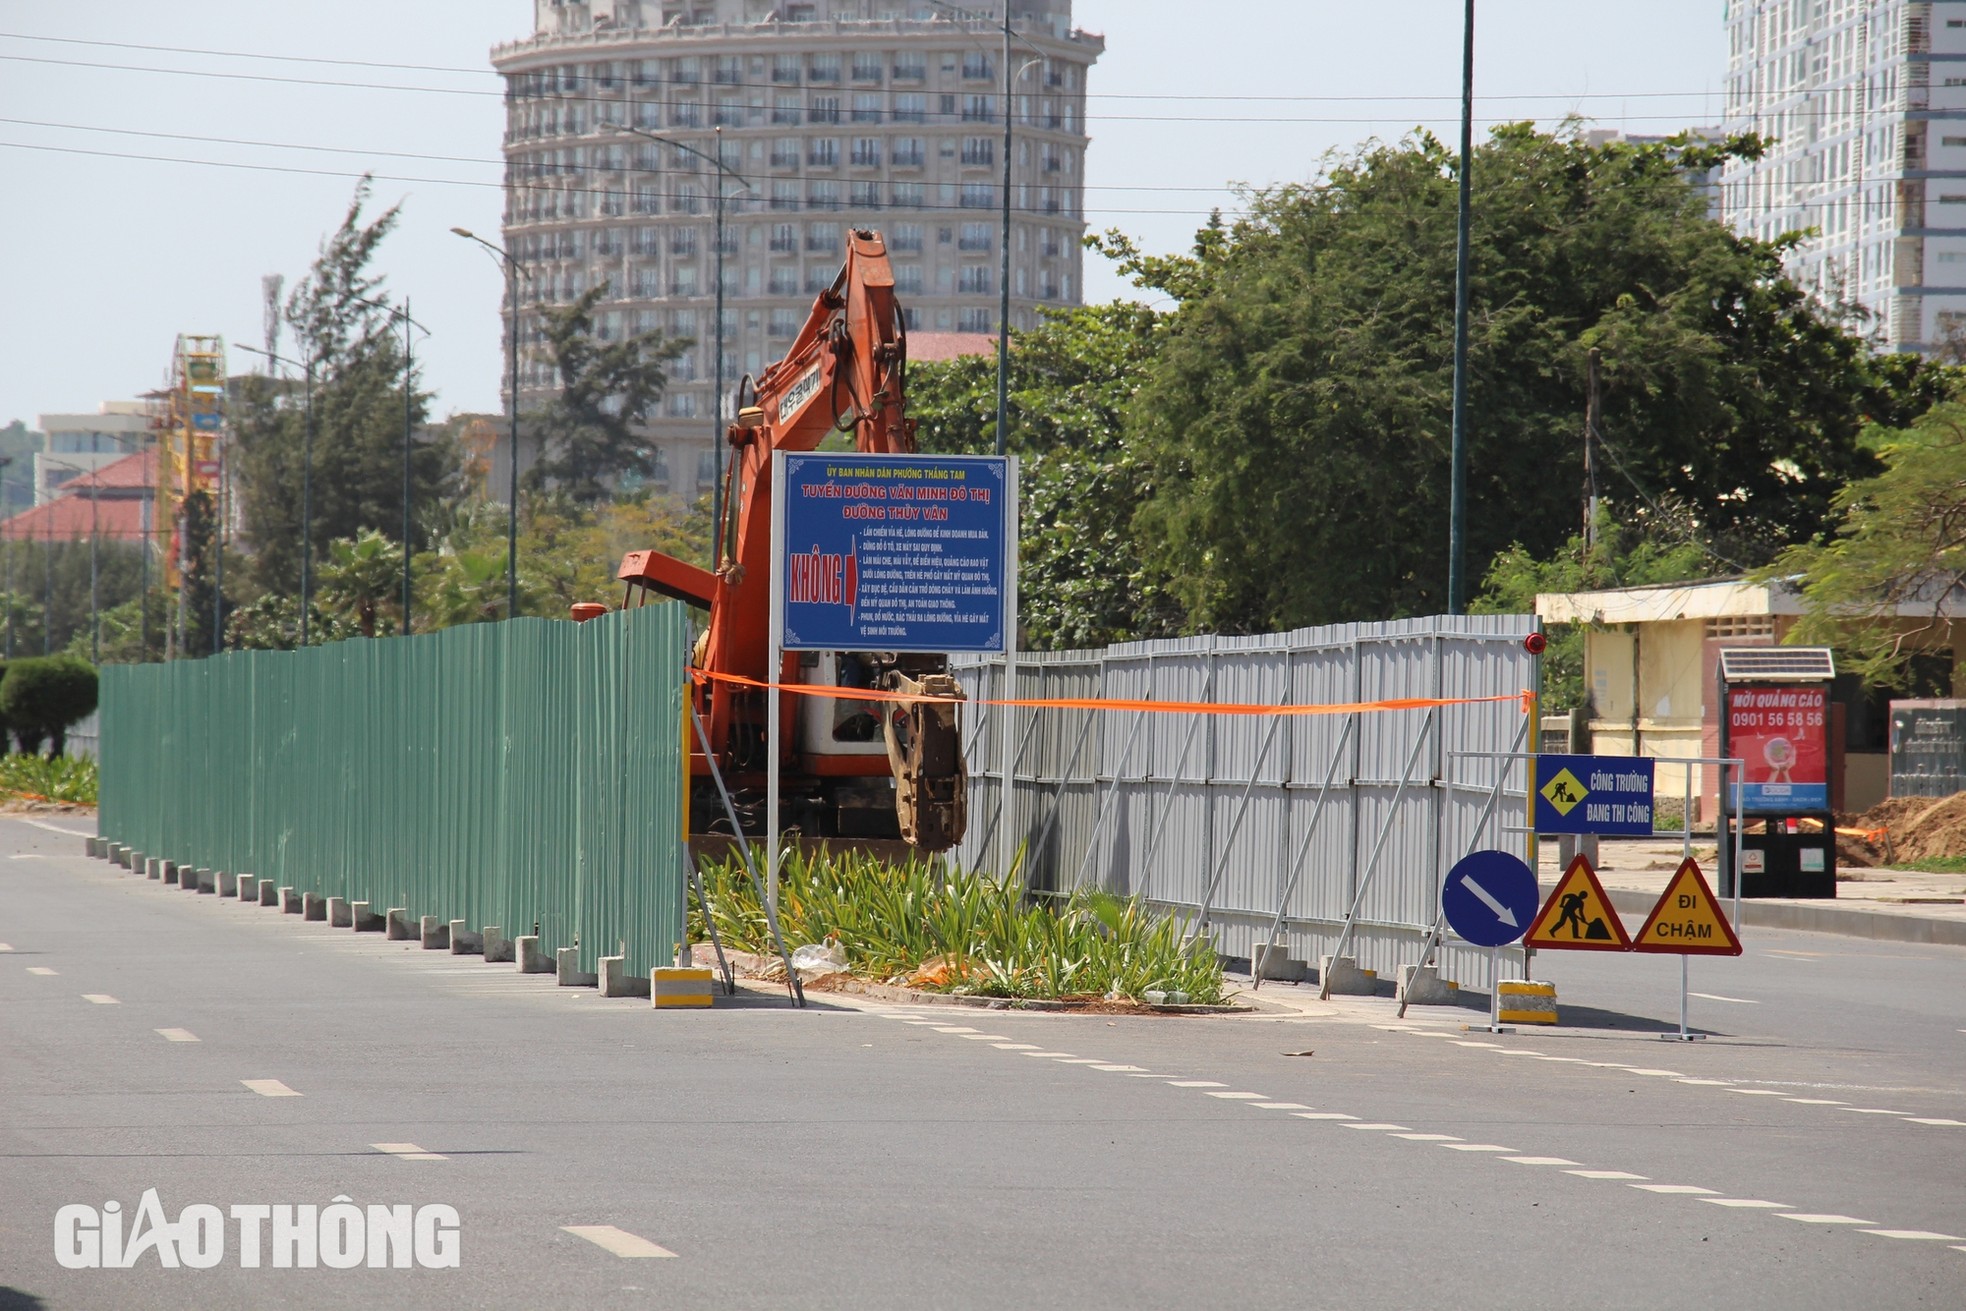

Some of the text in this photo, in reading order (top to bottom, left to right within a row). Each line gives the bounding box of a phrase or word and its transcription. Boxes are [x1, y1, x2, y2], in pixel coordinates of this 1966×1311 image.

[827, 464, 837, 477] ỦY
[838, 468, 853, 477] BAN
[854, 467, 875, 478] NHÂN
[876, 467, 892, 478] DÂN
[893, 467, 922, 479] PHƯỜNG
[950, 470, 965, 480] TAM
[802, 480, 990, 505] TUYẾN ĐƯỜNG VĂN MINH ĐÔ THỊ
[842, 503, 885, 519] ĐƯỜNG
[923, 504, 948, 521] VÂN
[790, 544, 841, 604] KHÔNG
[1733, 689, 1823, 708] MỜI QUẢNG CÁO
[1732, 712, 1823, 727] 0901 56 58 56
[1590, 769, 1649, 793] CÔNG TRƯỜNG
[1586, 801, 1650, 824] ĐANG THI CÔNG
[1679, 895, 1697, 909] ĐI
[1656, 919, 1712, 941] CHẬM
